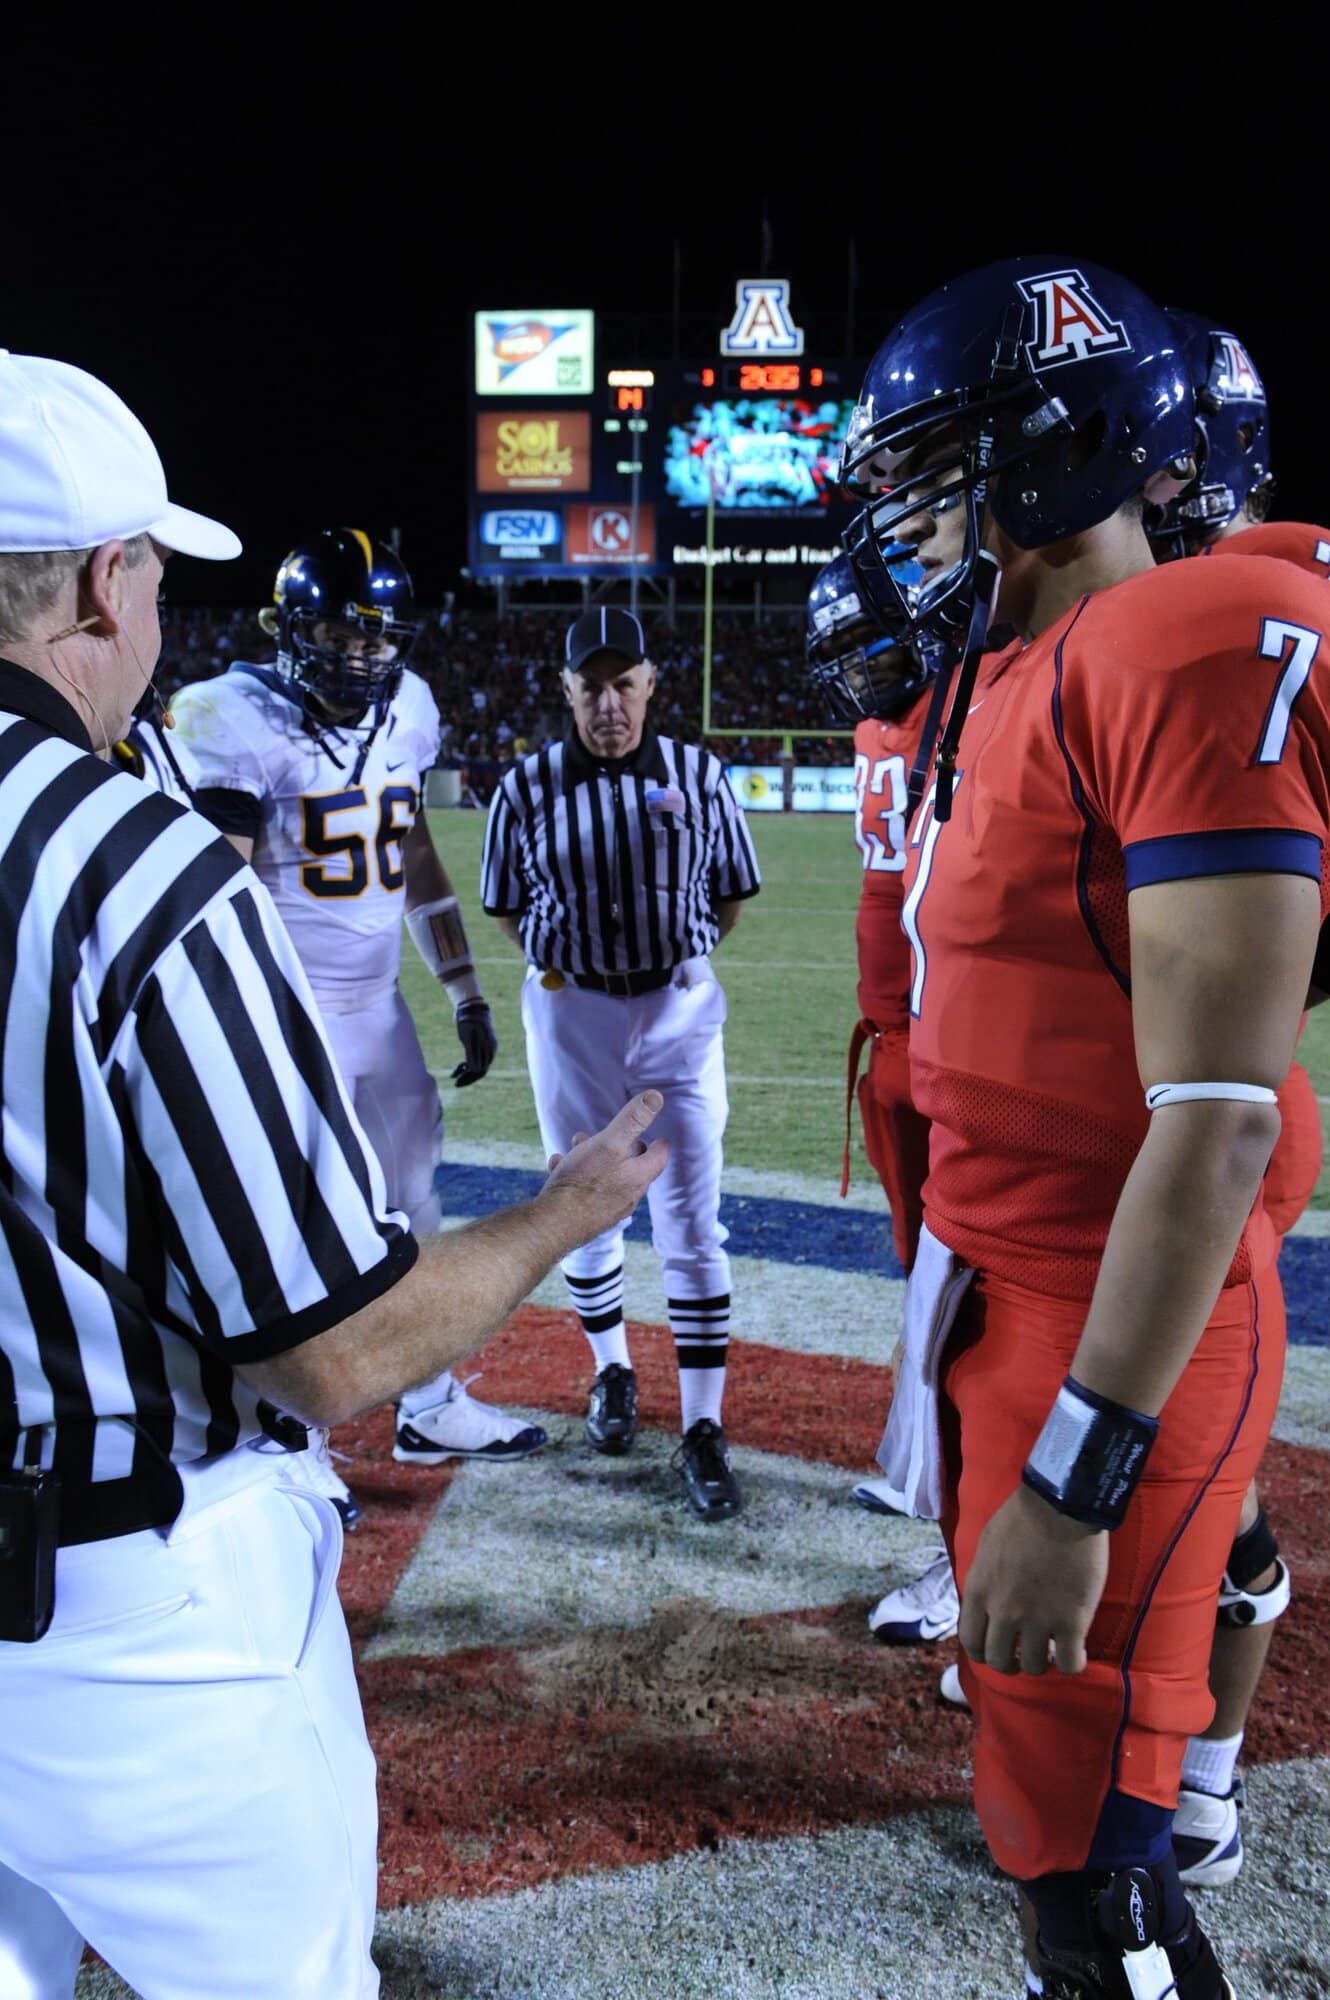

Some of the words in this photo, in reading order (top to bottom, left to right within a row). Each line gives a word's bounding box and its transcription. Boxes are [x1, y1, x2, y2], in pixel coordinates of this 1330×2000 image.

[720, 279, 804, 356] A
[1016, 269, 1132, 373] A
[1208, 331, 1266, 404] A
[497, 420, 572, 457] SOL
[495, 516, 546, 538] FSN
[1256, 615, 1323, 765] 7
[301, 783, 420, 899] 56
